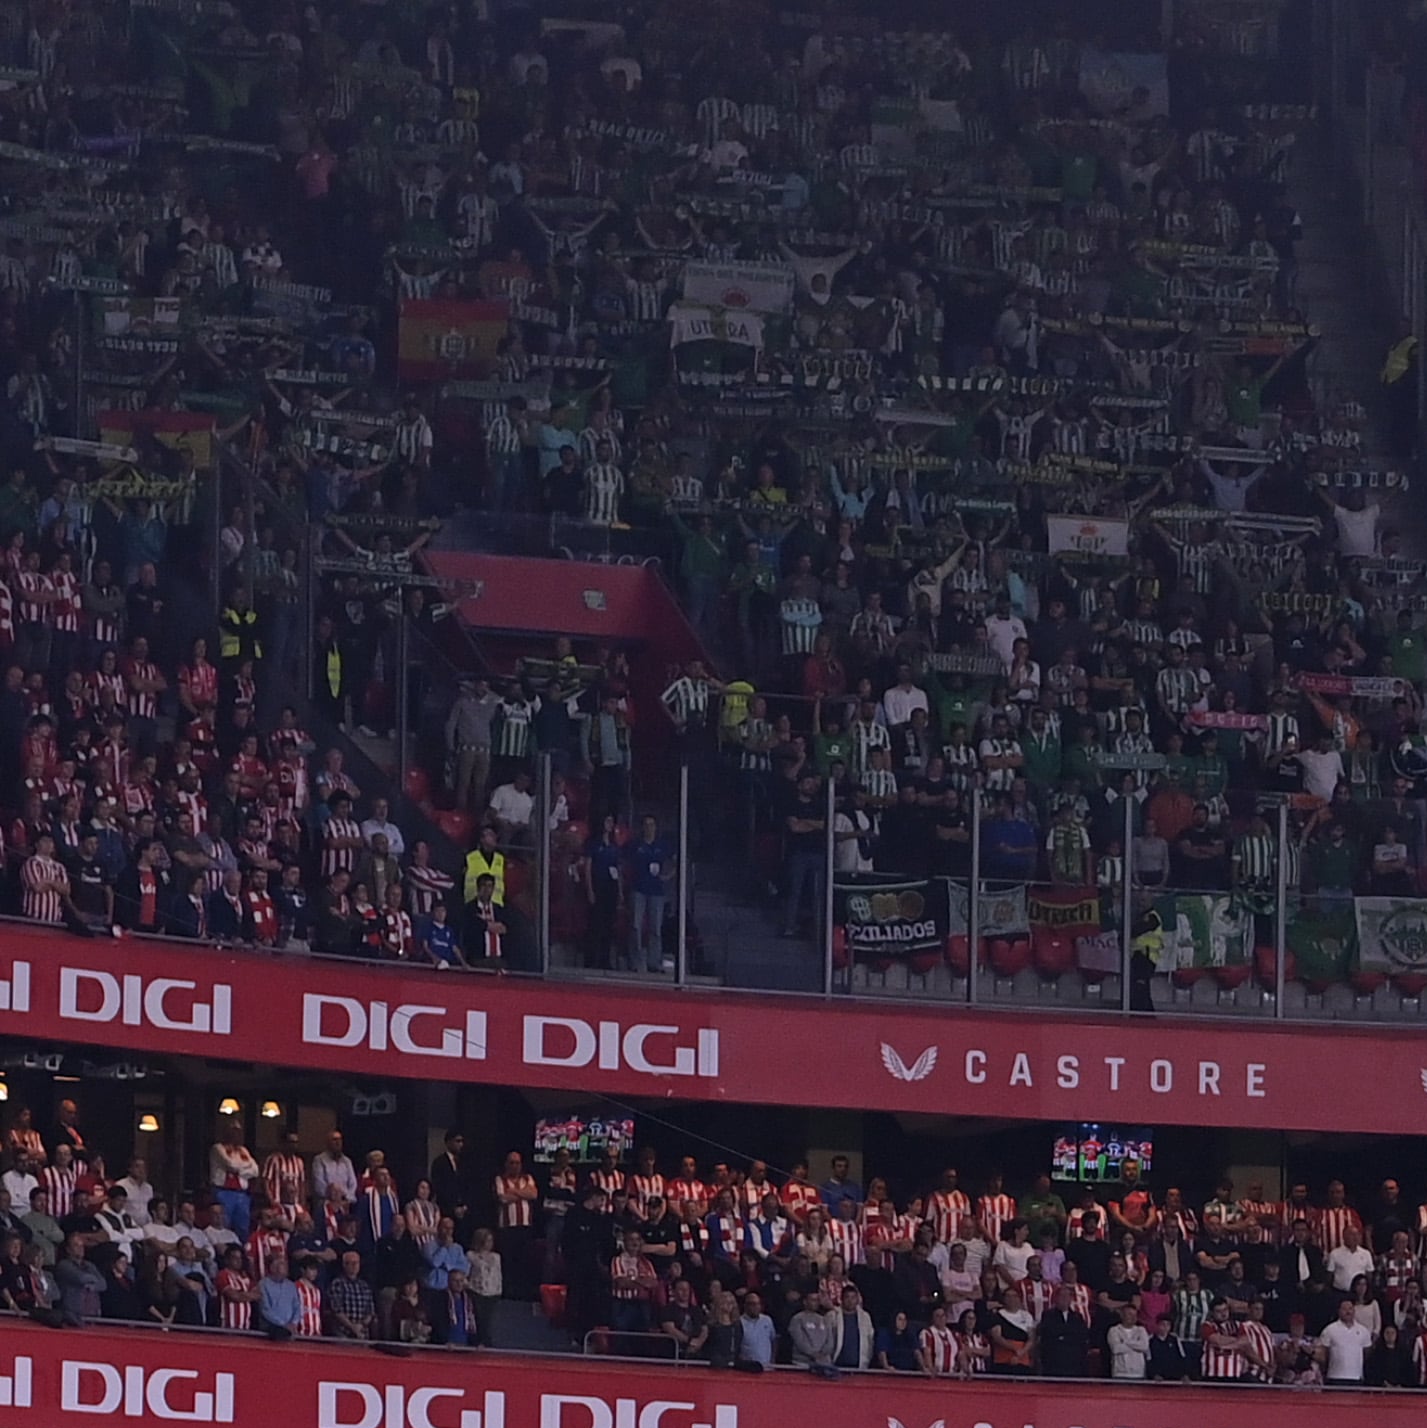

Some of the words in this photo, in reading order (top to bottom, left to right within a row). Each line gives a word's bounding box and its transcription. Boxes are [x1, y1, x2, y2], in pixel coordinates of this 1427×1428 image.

[59, 967, 232, 1035] DIGI
[302, 993, 487, 1060] DIGI
[522, 1015, 719, 1077] DIGI
[965, 1050, 1266, 1097] CASTORE
[61, 1360, 234, 1423] DIGI
